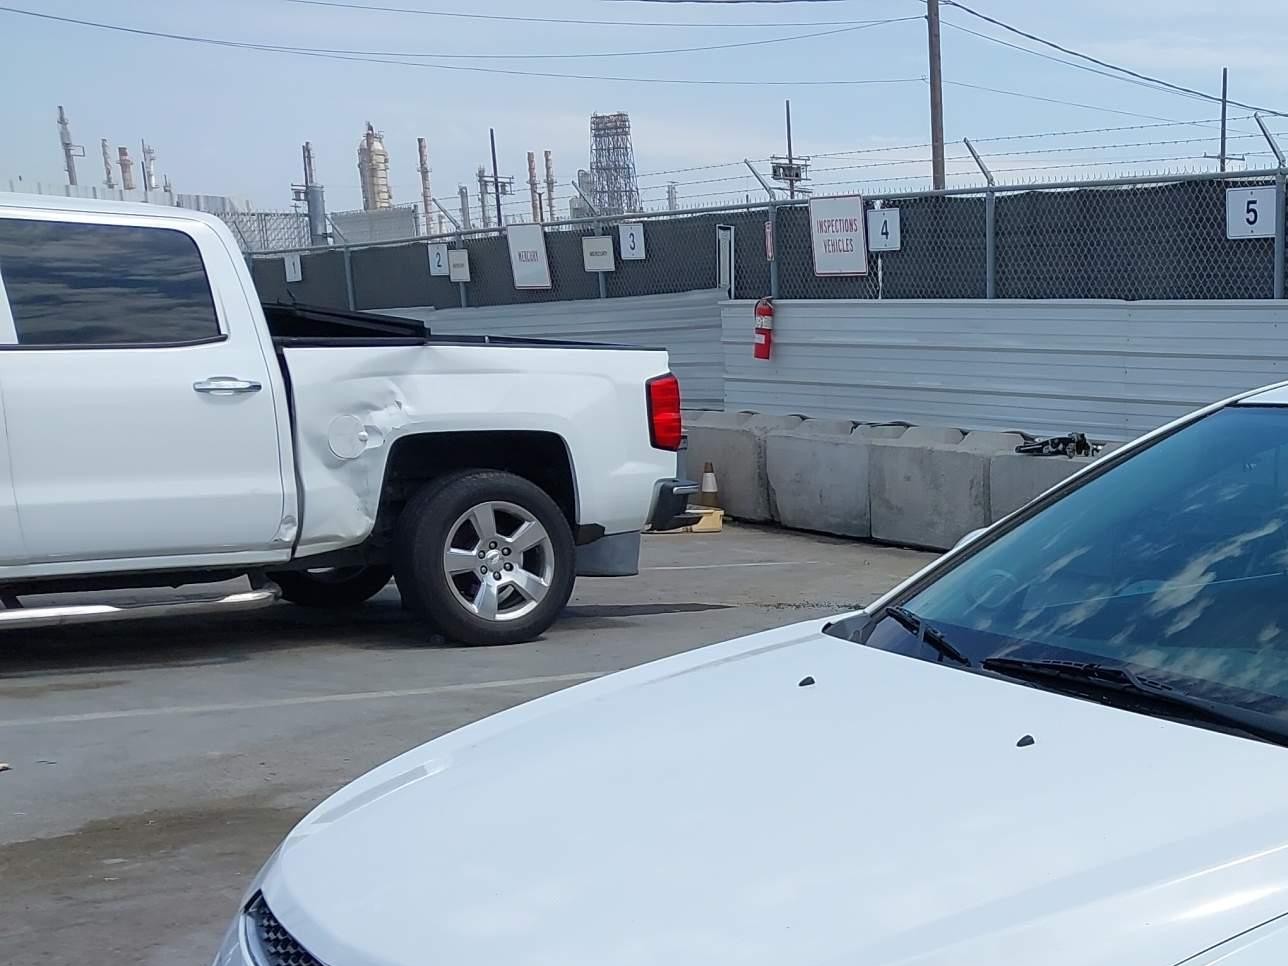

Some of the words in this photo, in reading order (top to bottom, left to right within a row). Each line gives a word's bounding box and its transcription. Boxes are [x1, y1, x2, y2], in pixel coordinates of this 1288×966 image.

[1245, 200, 1258, 225] 5
[816, 218, 858, 234] INSPECTIONS
[880, 219, 890, 241] 4
[628, 232, 636, 251] 3
[823, 238, 854, 254] VEHICLES
[435, 252, 443, 268] 2
